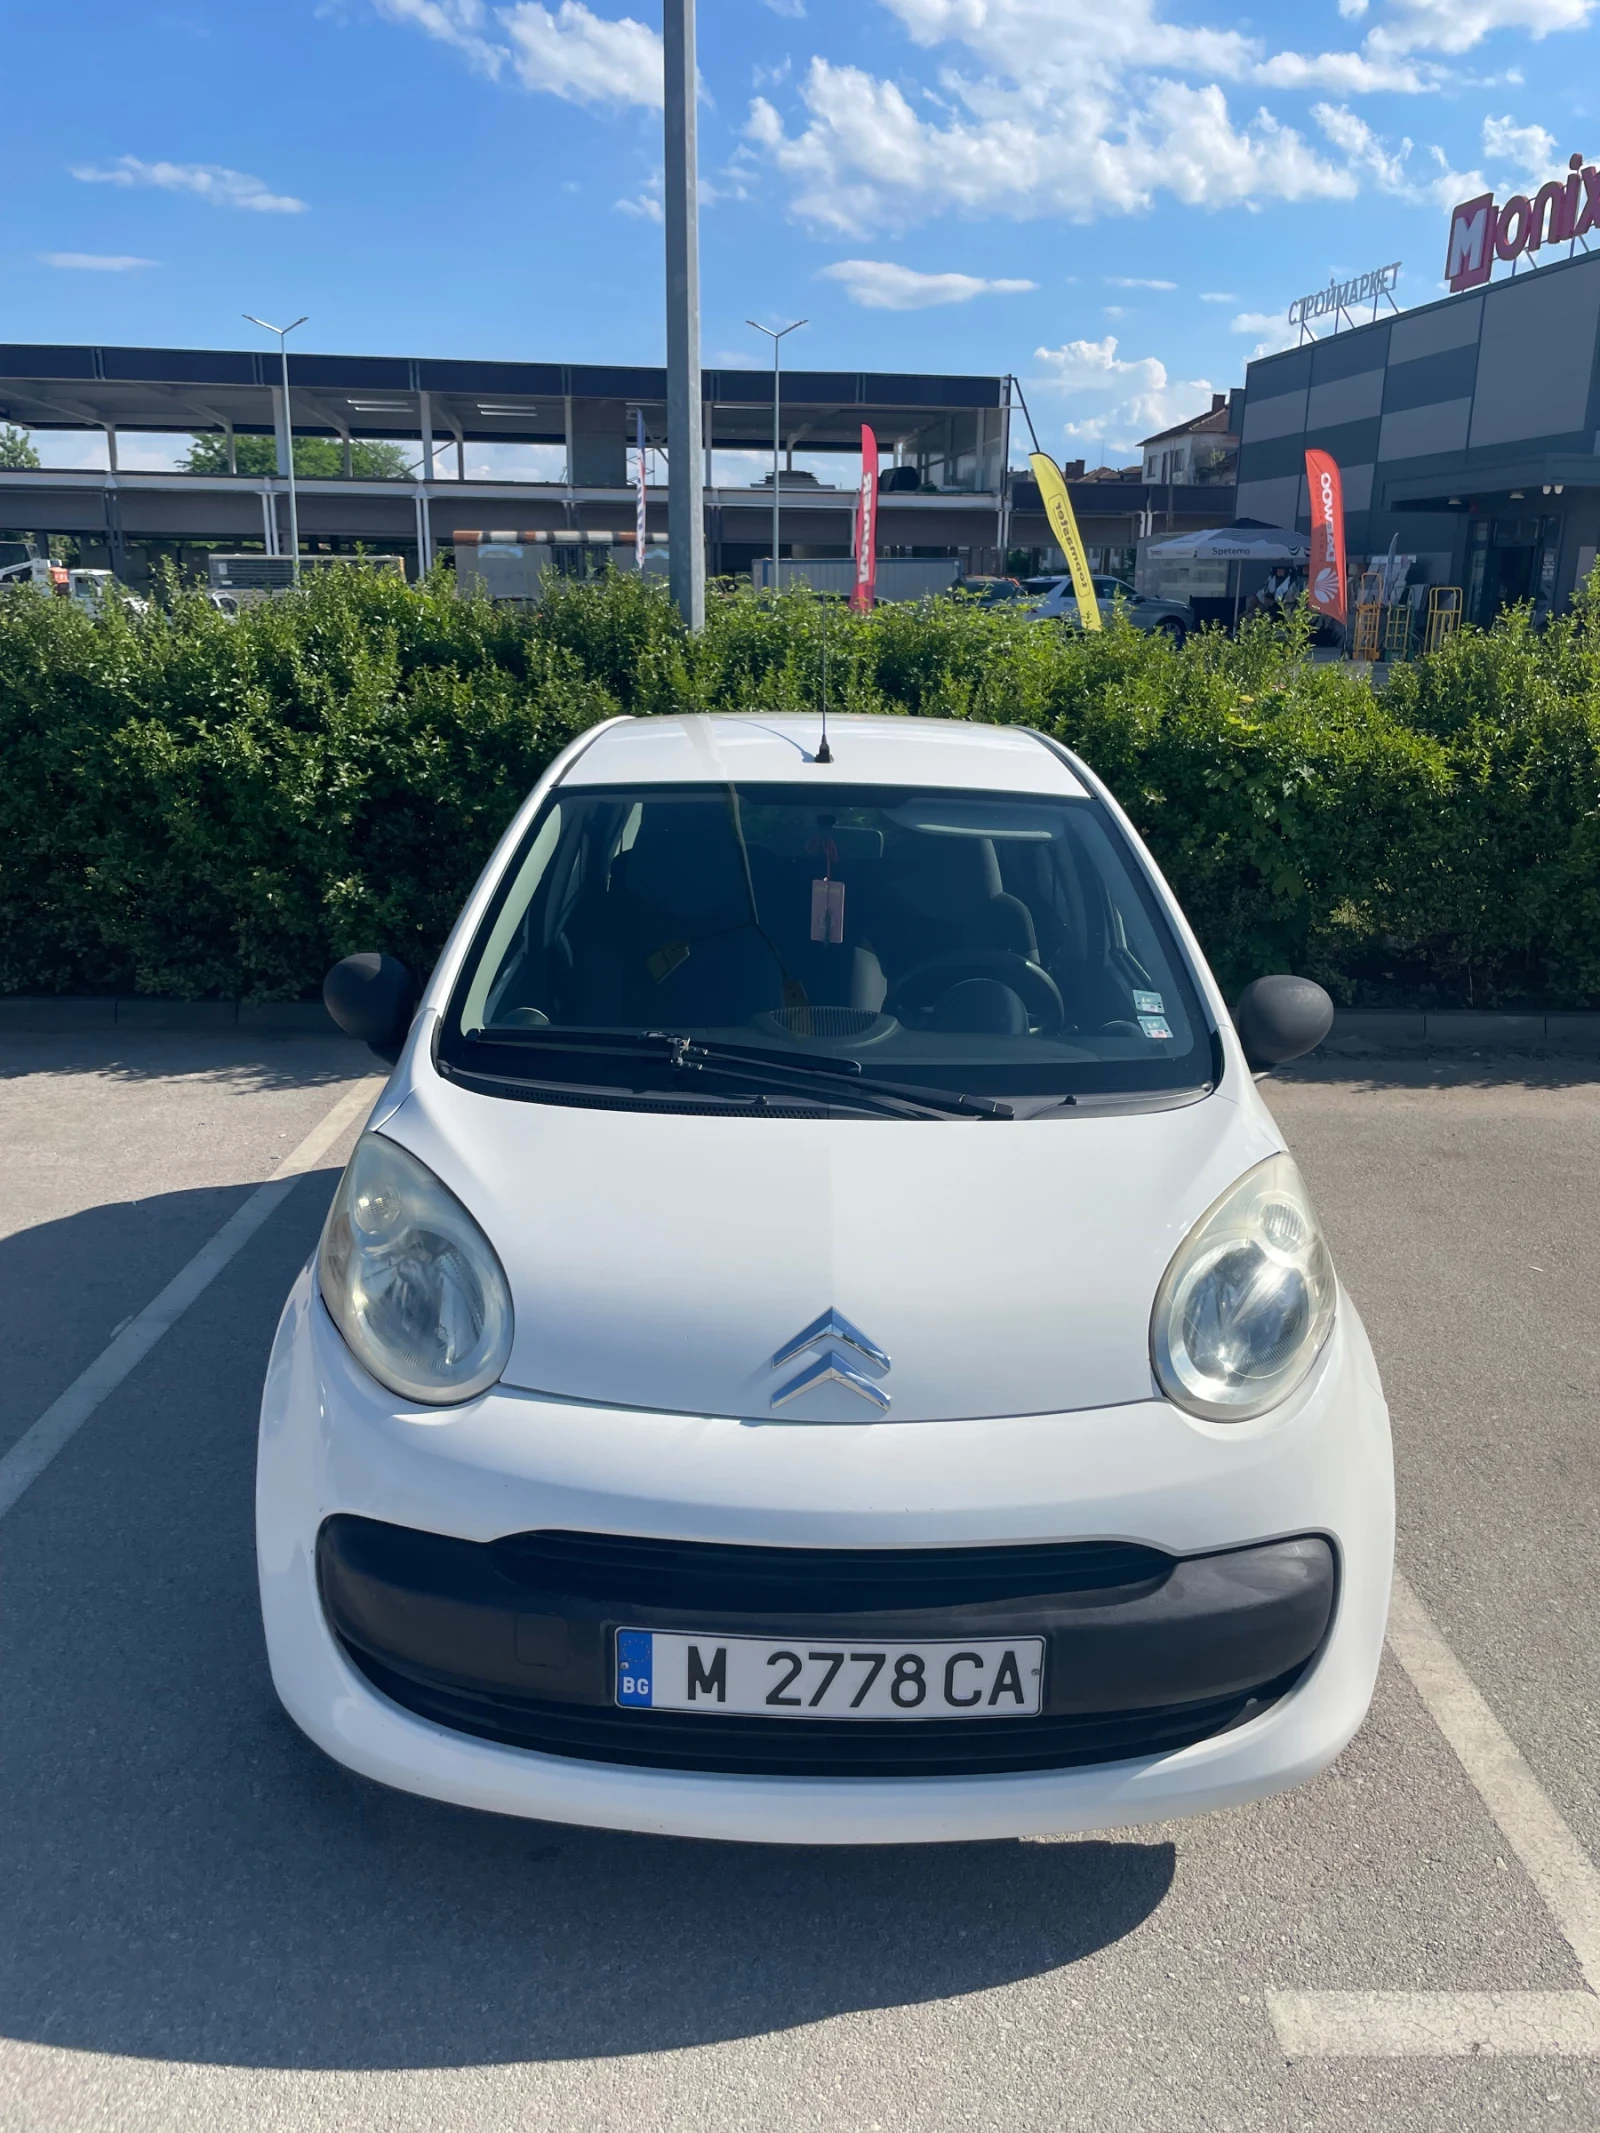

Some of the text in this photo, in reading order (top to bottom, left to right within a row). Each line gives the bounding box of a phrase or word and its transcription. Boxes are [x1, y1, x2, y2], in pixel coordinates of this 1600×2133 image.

[1288, 261, 1402, 325] СТРОЙМАРКЕТ
[622, 1676, 650, 1695] BG
[687, 1645, 727, 1703] M
